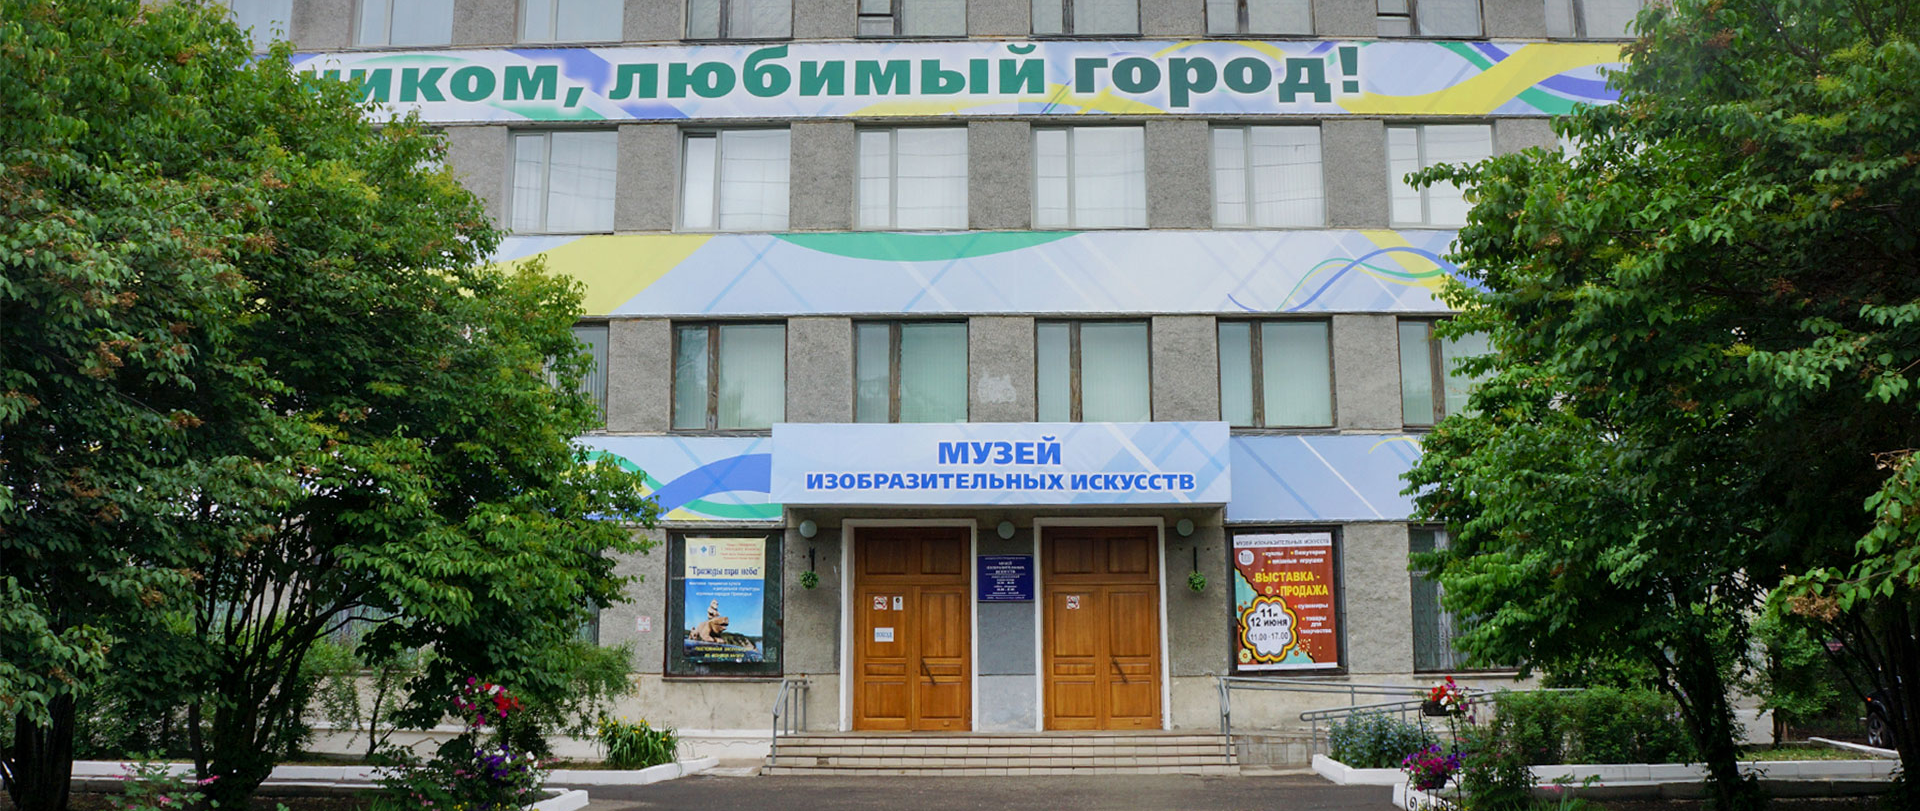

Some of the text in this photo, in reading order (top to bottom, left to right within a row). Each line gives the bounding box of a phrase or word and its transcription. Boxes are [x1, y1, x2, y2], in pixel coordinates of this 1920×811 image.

[609, 44, 1046, 100] любимый
[1074, 46, 1360, 108] город!
[937, 435, 1062, 466] МУЗЕЙ
[806, 473, 1195, 491] ИЗОБРАЗИТЕЛЬНЫХ ИСКУССТВ
[1255, 571, 1314, 583] ВЫСТАВКА
[1280, 584, 1328, 597] ПРОДАЖА
[1260, 608, 1272, 618] 11
[1251, 617, 1261, 627] 12
